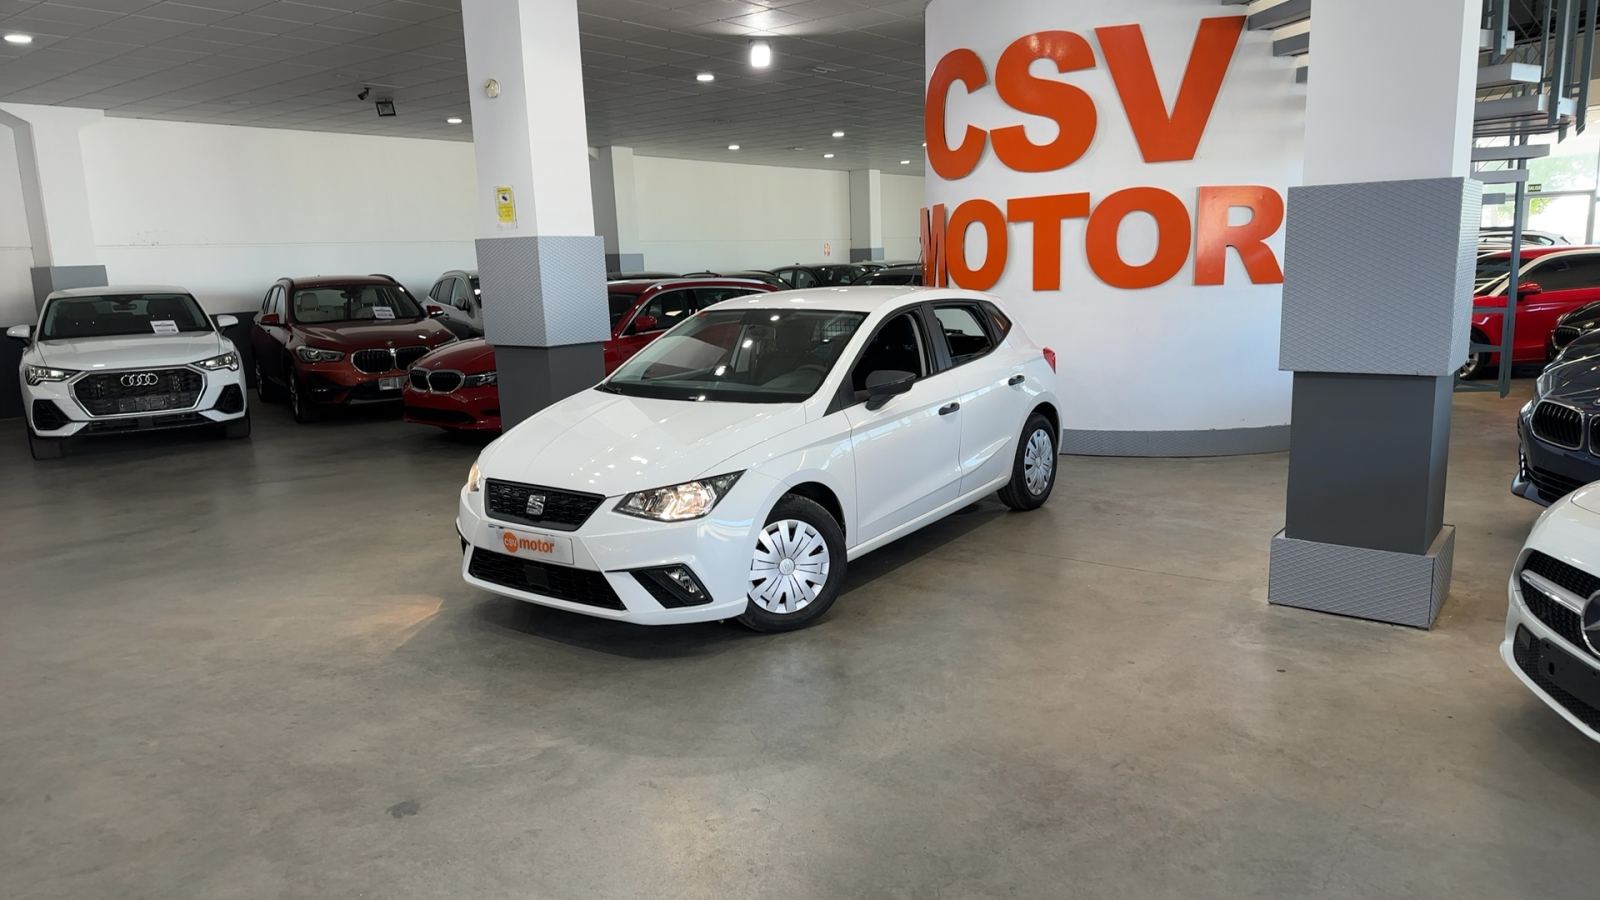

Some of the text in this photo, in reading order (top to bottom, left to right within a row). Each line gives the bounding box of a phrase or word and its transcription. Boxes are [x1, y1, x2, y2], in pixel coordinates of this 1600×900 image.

[924, 15, 1247, 181] CSV
[920, 186, 1284, 291] MOTOR
[519, 538, 554, 553] motor
